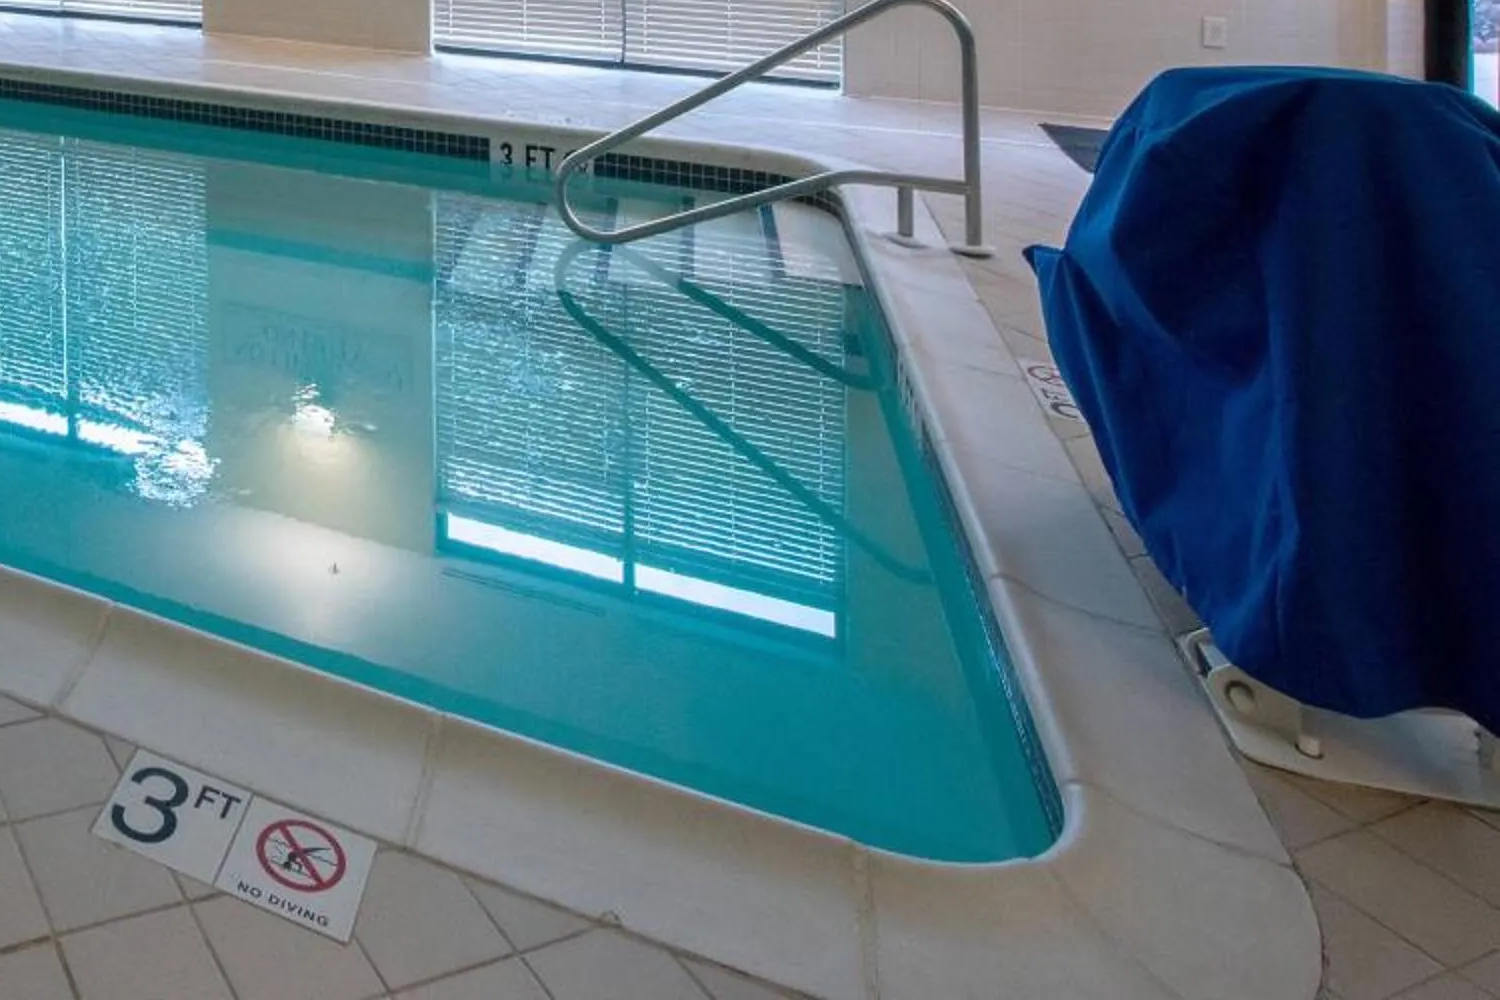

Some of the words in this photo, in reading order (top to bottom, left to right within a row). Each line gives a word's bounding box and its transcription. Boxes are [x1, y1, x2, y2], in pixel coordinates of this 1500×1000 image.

[501, 142, 513, 165] 3
[525, 144, 555, 168] FT
[111, 767, 189, 844] 3
[194, 785, 241, 820] FT
[237, 879, 263, 899] NO
[268, 893, 329, 928] DIVING
